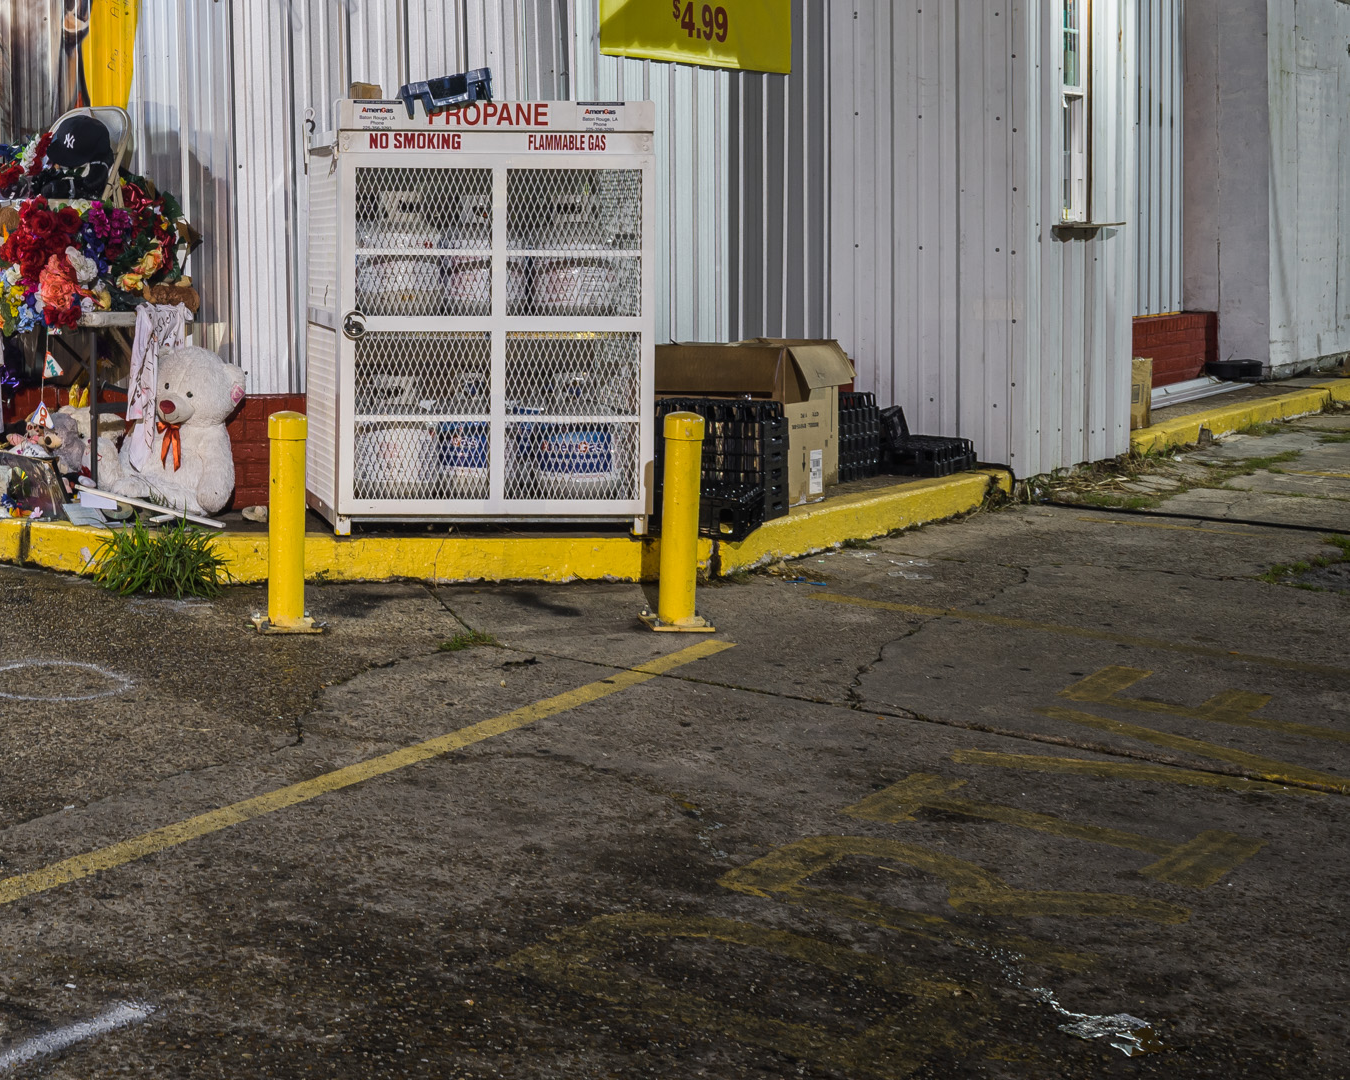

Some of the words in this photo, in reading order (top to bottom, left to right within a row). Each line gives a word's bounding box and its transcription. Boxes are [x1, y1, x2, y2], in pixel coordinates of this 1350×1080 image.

[428, 102, 549, 126] PROPANE
[369, 133, 389, 149] NO
[394, 133, 462, 150] SMOKING
[528, 134, 586, 151] FLAMMABLE
[588, 134, 606, 151] GAS
